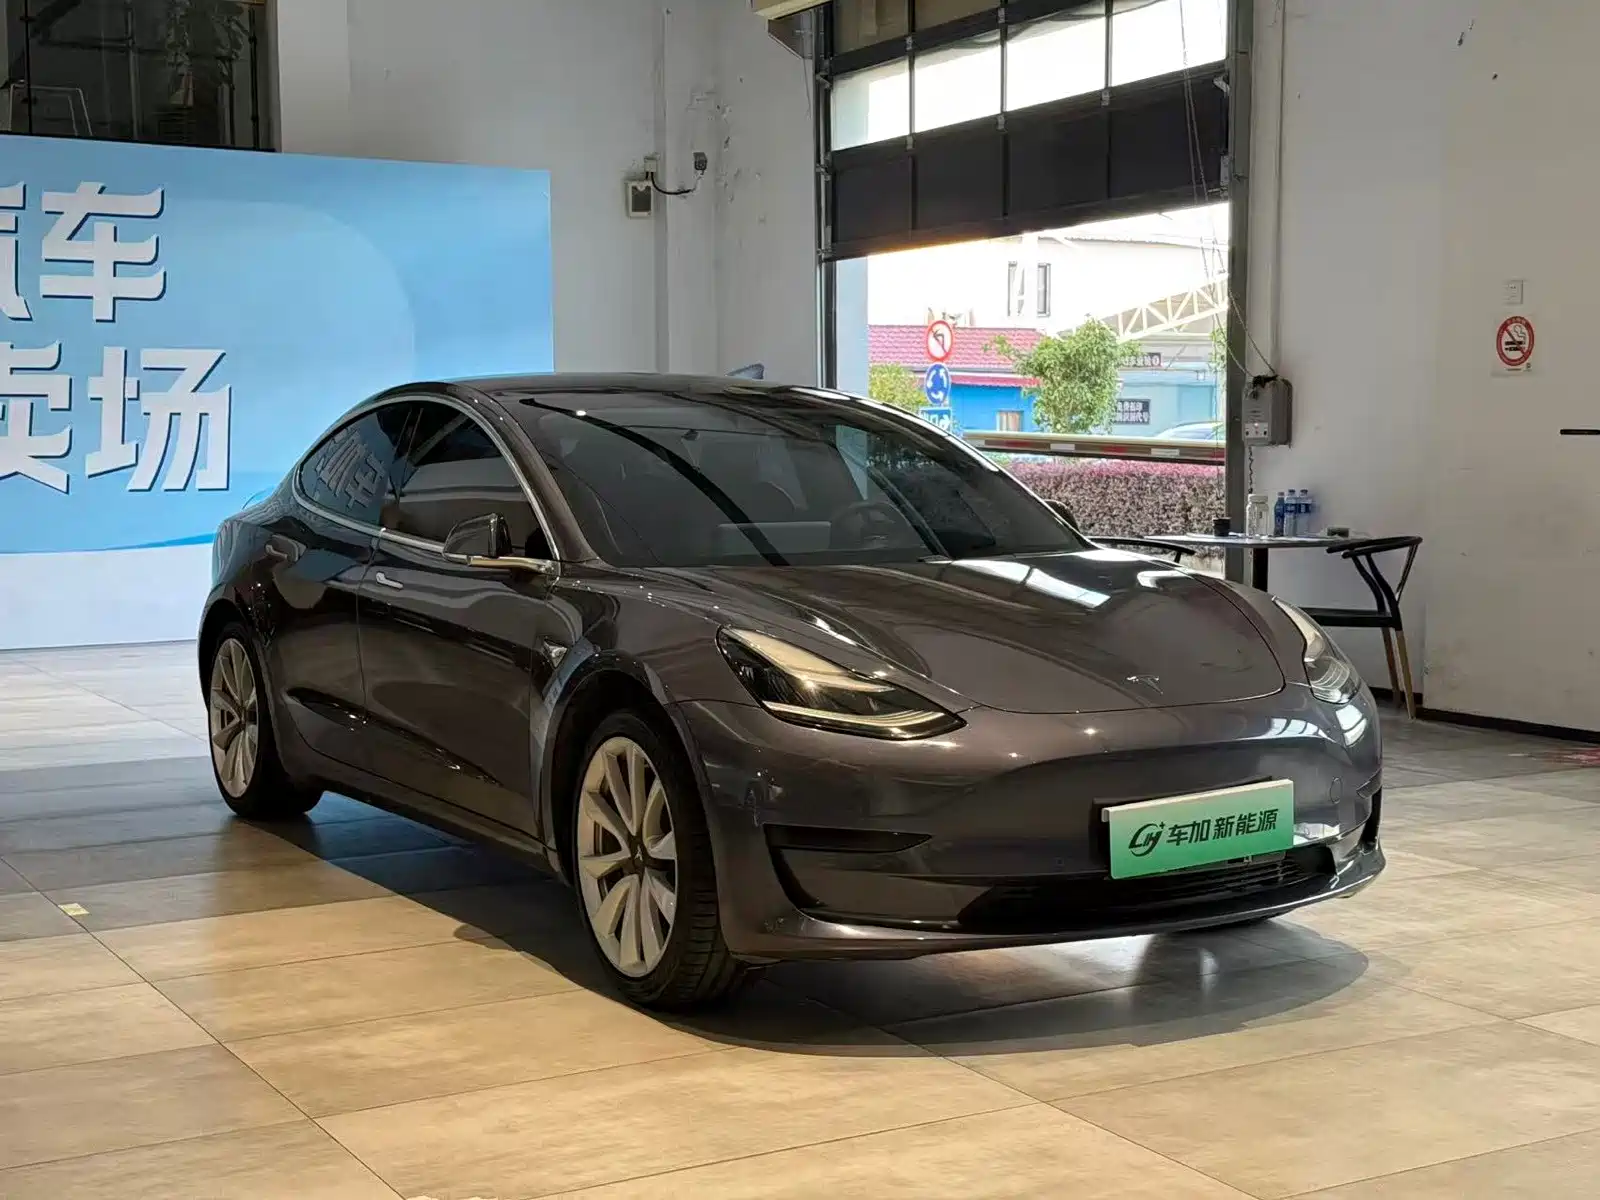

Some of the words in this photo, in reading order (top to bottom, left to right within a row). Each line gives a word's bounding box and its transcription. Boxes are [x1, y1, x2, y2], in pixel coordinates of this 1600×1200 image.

[0, 181, 166, 322] 车
[1166, 808, 1279, 846] 车加新能源
